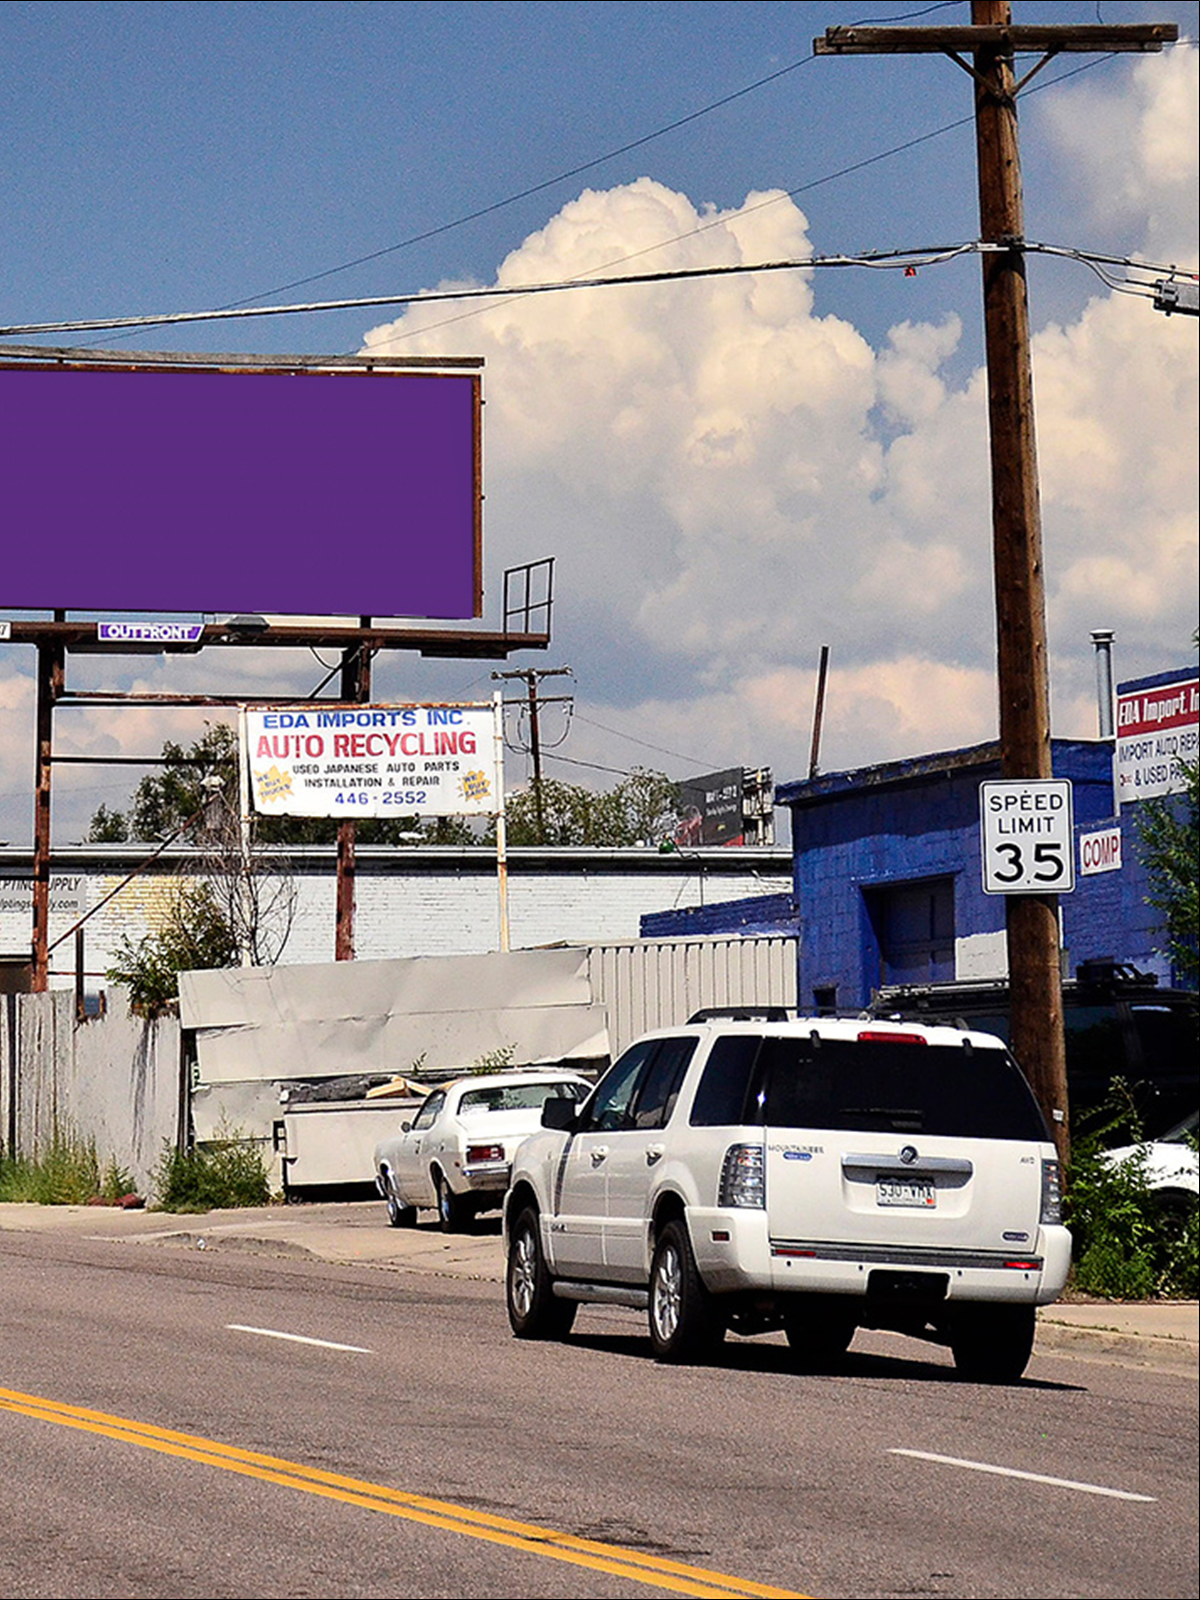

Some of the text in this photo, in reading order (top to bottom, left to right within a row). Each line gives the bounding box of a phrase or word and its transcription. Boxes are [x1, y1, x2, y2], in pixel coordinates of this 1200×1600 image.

[108, 625, 192, 638] OUTFRONT
[263, 714, 310, 729] EDA
[317, 711, 416, 728] IMPORTS
[1118, 699, 1140, 727] EDA
[256, 731, 477, 758] AUTO RECYCLING
[1118, 741, 1153, 763] IMPORT
[1155, 735, 1179, 758] AUTO
[292, 761, 460, 775] USED JAPANESE AUTO PARTS
[1143, 764, 1168, 785] USED
[304, 776, 440, 788] INSTALLATION & REPAIR
[990, 794, 1063, 812] SPEED
[998, 817, 1055, 834] LIMIT
[1083, 835, 1119, 867] COMP
[993, 843, 1064, 883] 35
[47, 877, 82, 891] UPPLY
